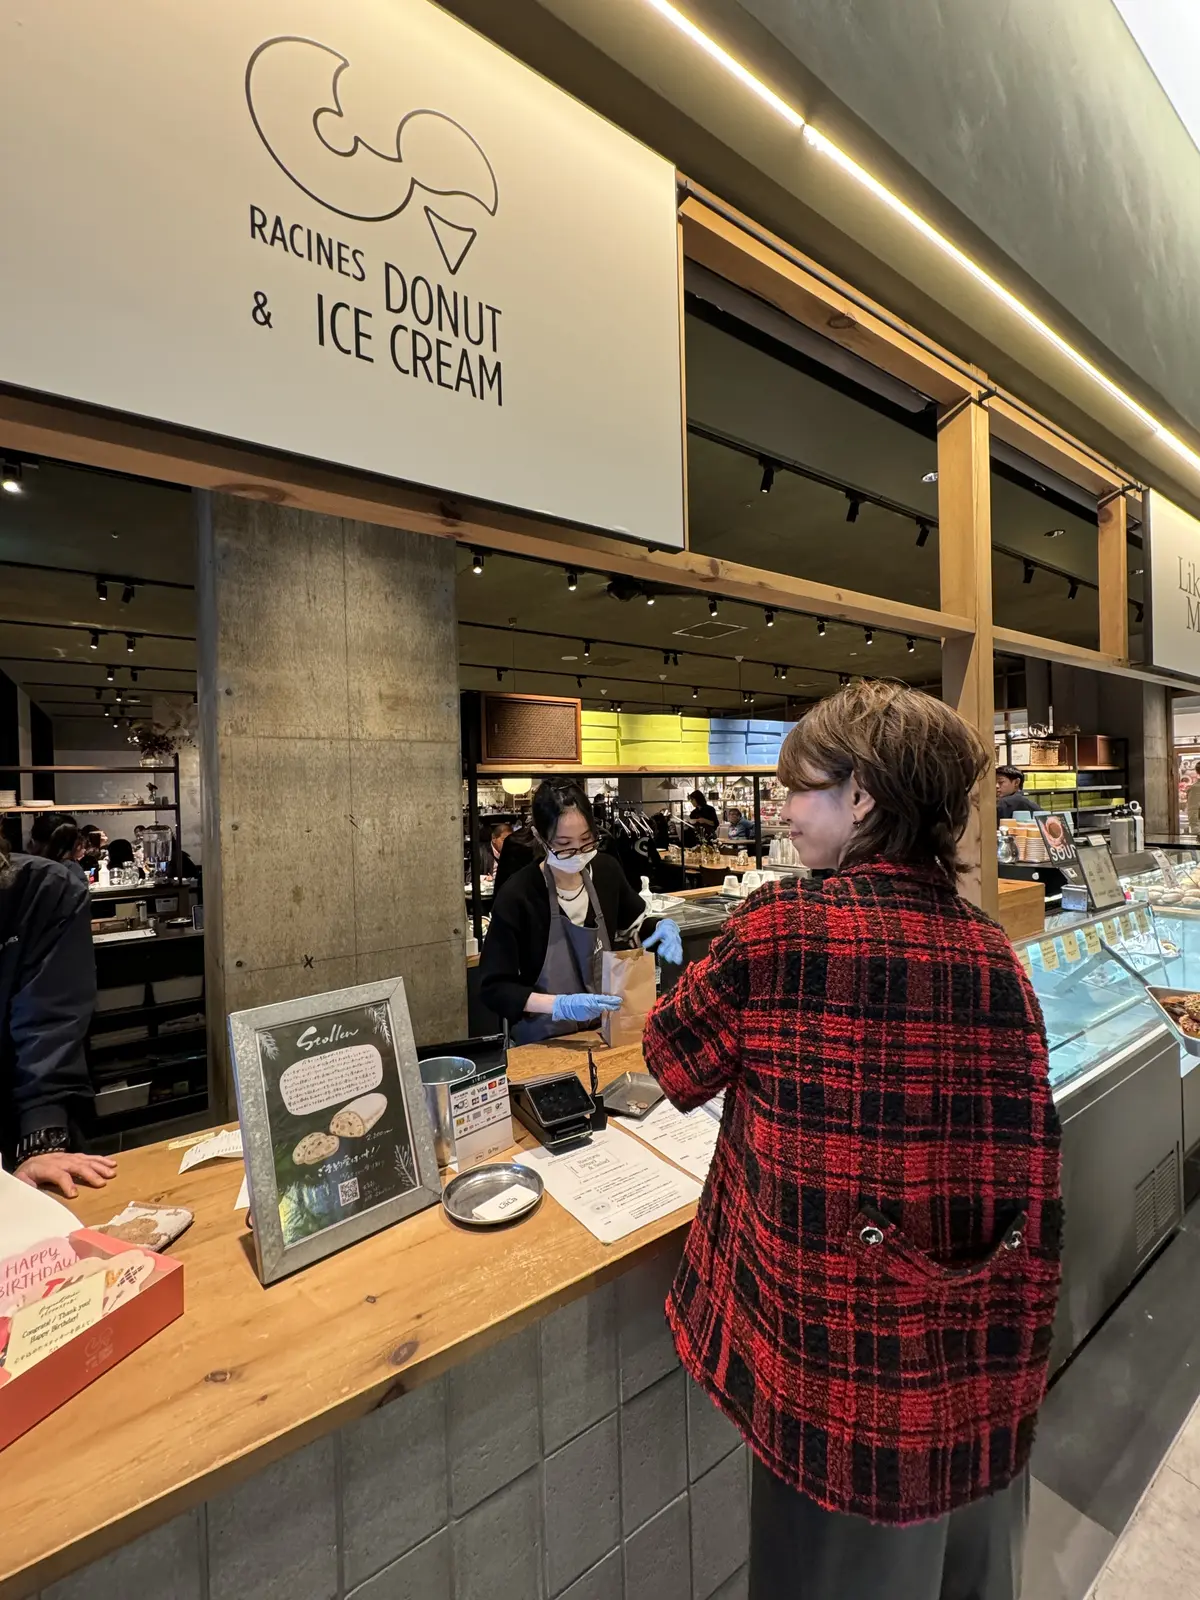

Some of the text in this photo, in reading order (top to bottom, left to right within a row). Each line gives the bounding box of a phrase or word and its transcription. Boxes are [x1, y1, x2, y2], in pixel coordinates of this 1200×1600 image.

[250, 204, 502, 353] RACINES DONUT
[251, 291, 503, 407] & ICE CREAM
[5, 1247, 60, 1279] HAPPY
